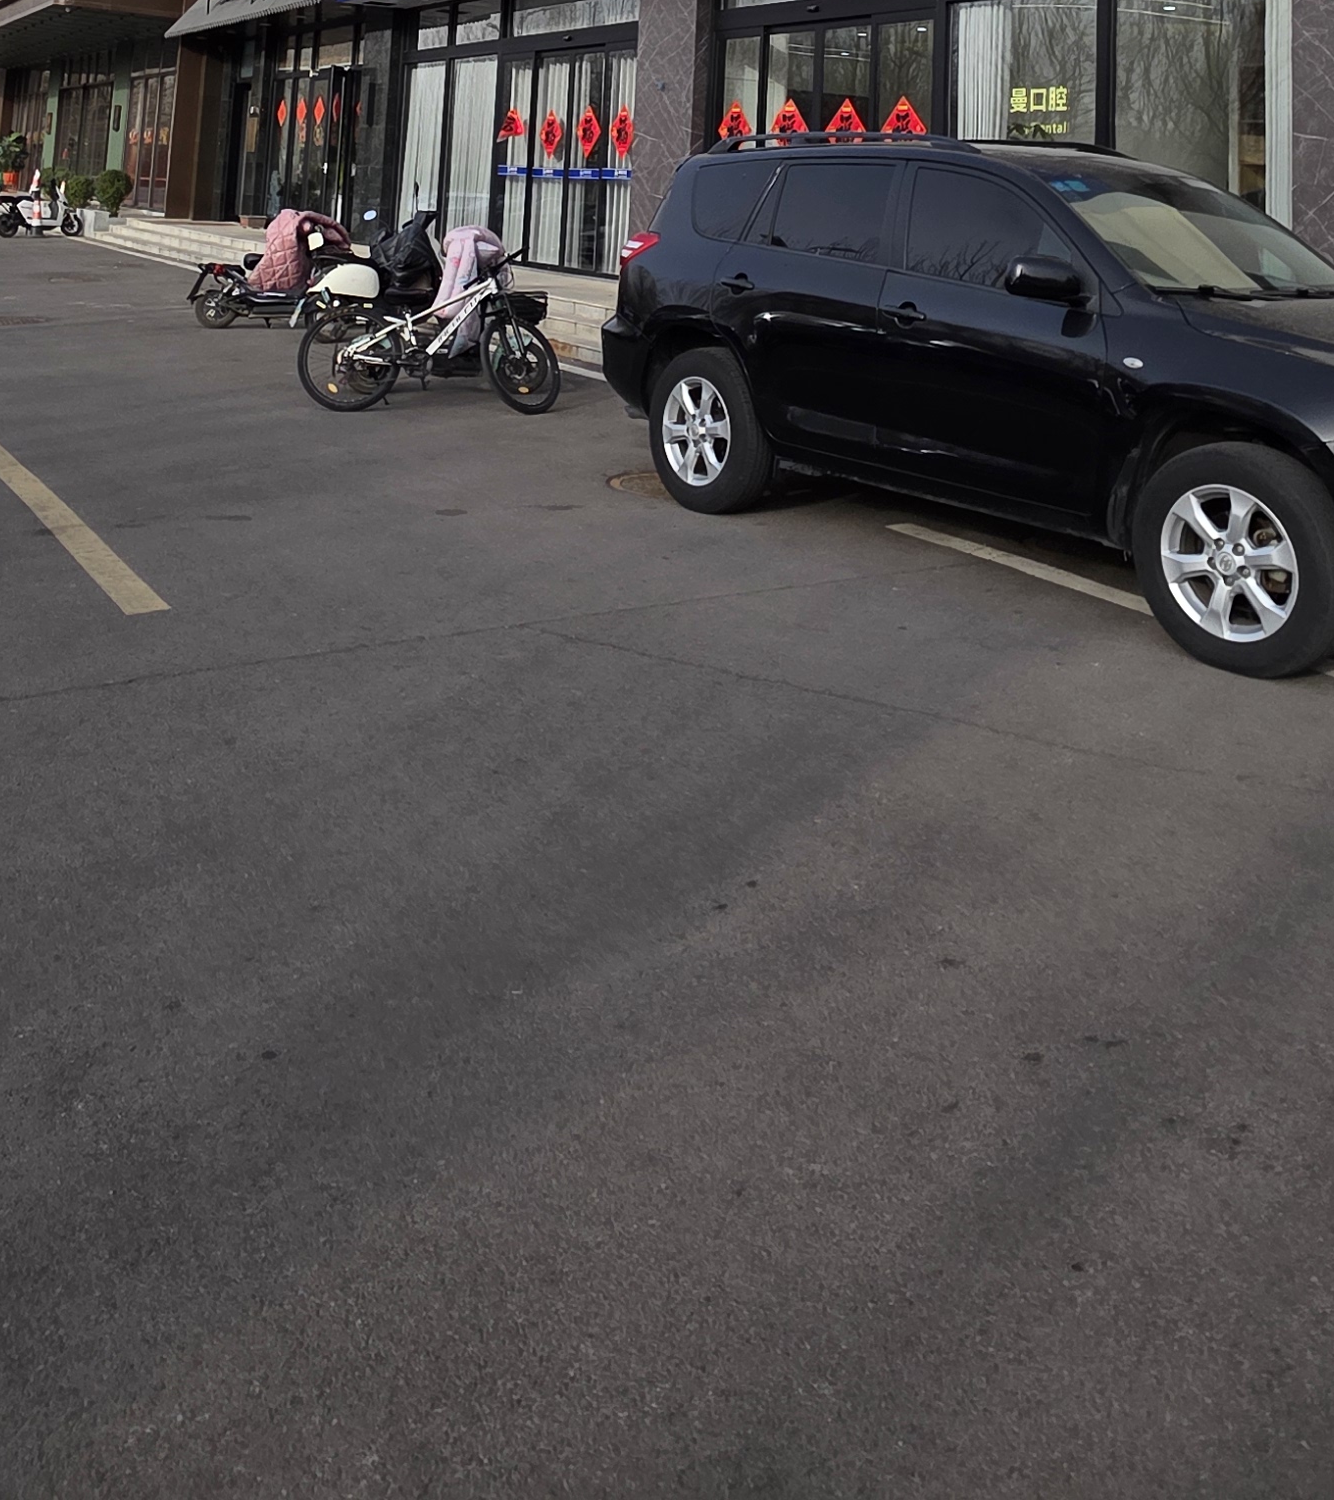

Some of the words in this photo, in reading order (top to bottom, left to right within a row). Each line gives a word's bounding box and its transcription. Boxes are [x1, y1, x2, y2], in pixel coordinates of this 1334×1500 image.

[1010, 85, 1068, 113] 曼口腔
[1030, 121, 1068, 134] ntal
